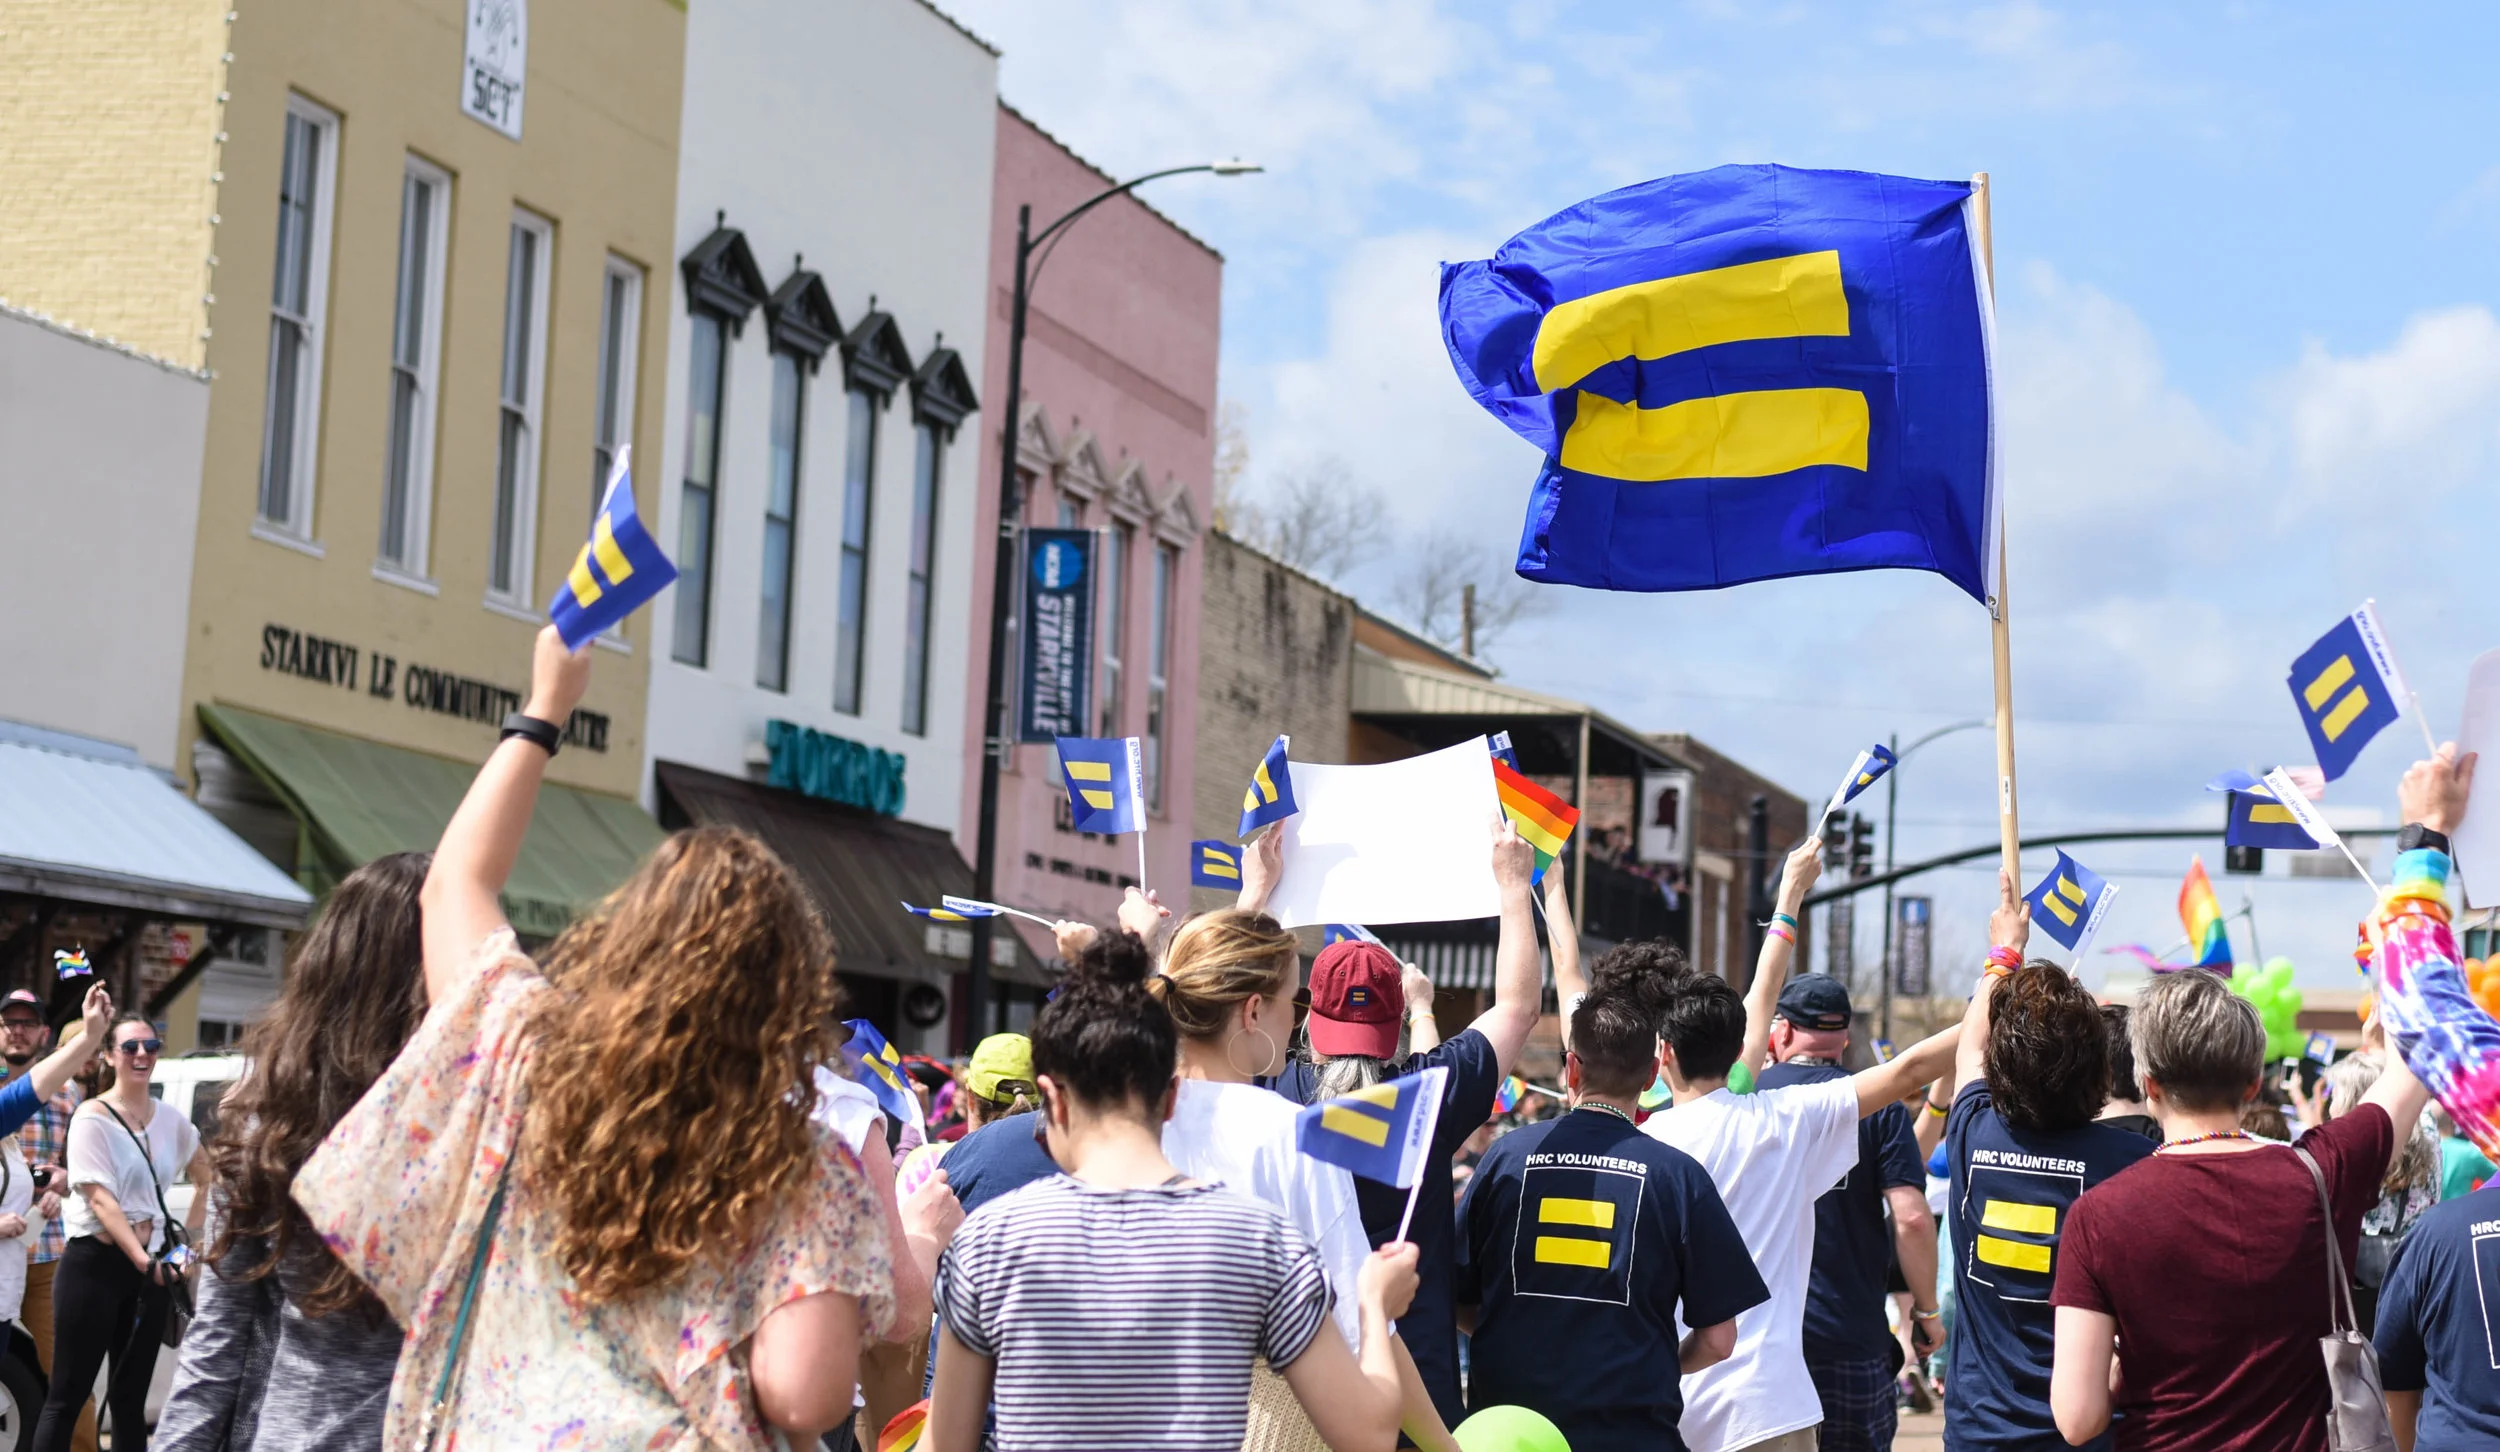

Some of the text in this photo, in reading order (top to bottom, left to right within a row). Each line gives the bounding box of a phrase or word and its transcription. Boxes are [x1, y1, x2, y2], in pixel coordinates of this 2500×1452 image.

[1044, 541, 1060, 588] NCAA
[1033, 593, 1061, 733] STARKVILLE
[1525, 1153, 1648, 1175] HRC VOLUNTEERS
[1972, 1149, 2086, 1174] HRC VOLUNTEERS
[2470, 1220, 2500, 1236] HRC
